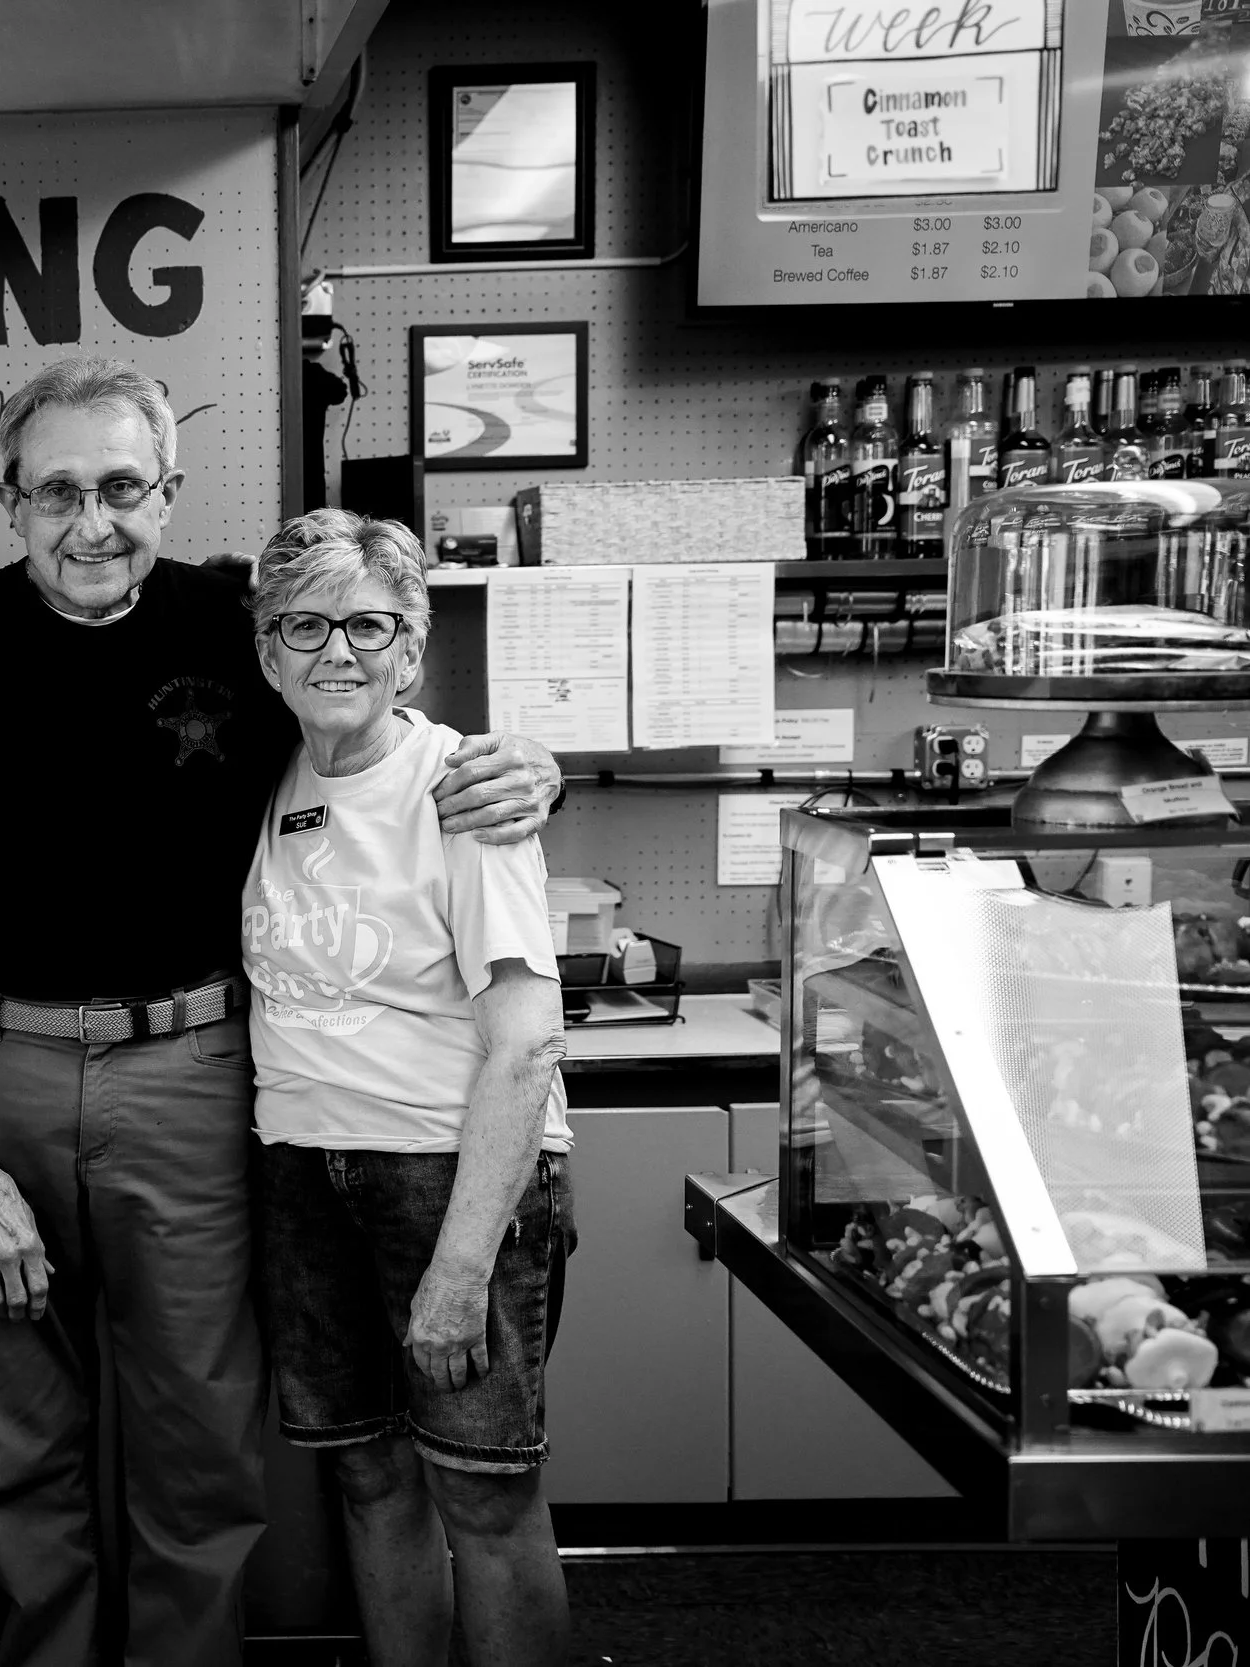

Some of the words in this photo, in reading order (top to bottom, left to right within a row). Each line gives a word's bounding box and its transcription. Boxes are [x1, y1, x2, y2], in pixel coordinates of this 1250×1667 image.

[863, 87, 967, 114] Cinnamon
[880, 117, 941, 140] Toast
[866, 142, 953, 166] Crunch
[788, 219, 858, 234] Americano
[913, 217, 952, 233] $3.00
[983, 215, 1022, 231] $3.00
[811, 244, 833, 258] Tea
[911, 241, 949, 257] $1.87
[981, 240, 1020, 256] $2.10
[773, 269, 822, 283] Brewed
[825, 268, 870, 282] Coffee
[910, 266, 948, 282] $1.87
[980, 264, 1019, 280] $2.10
[468, 357, 525, 370] ServSafe
[296, 820, 307, 829] SUE
[257, 879, 295, 901] The
[242, 903, 349, 958] Party
